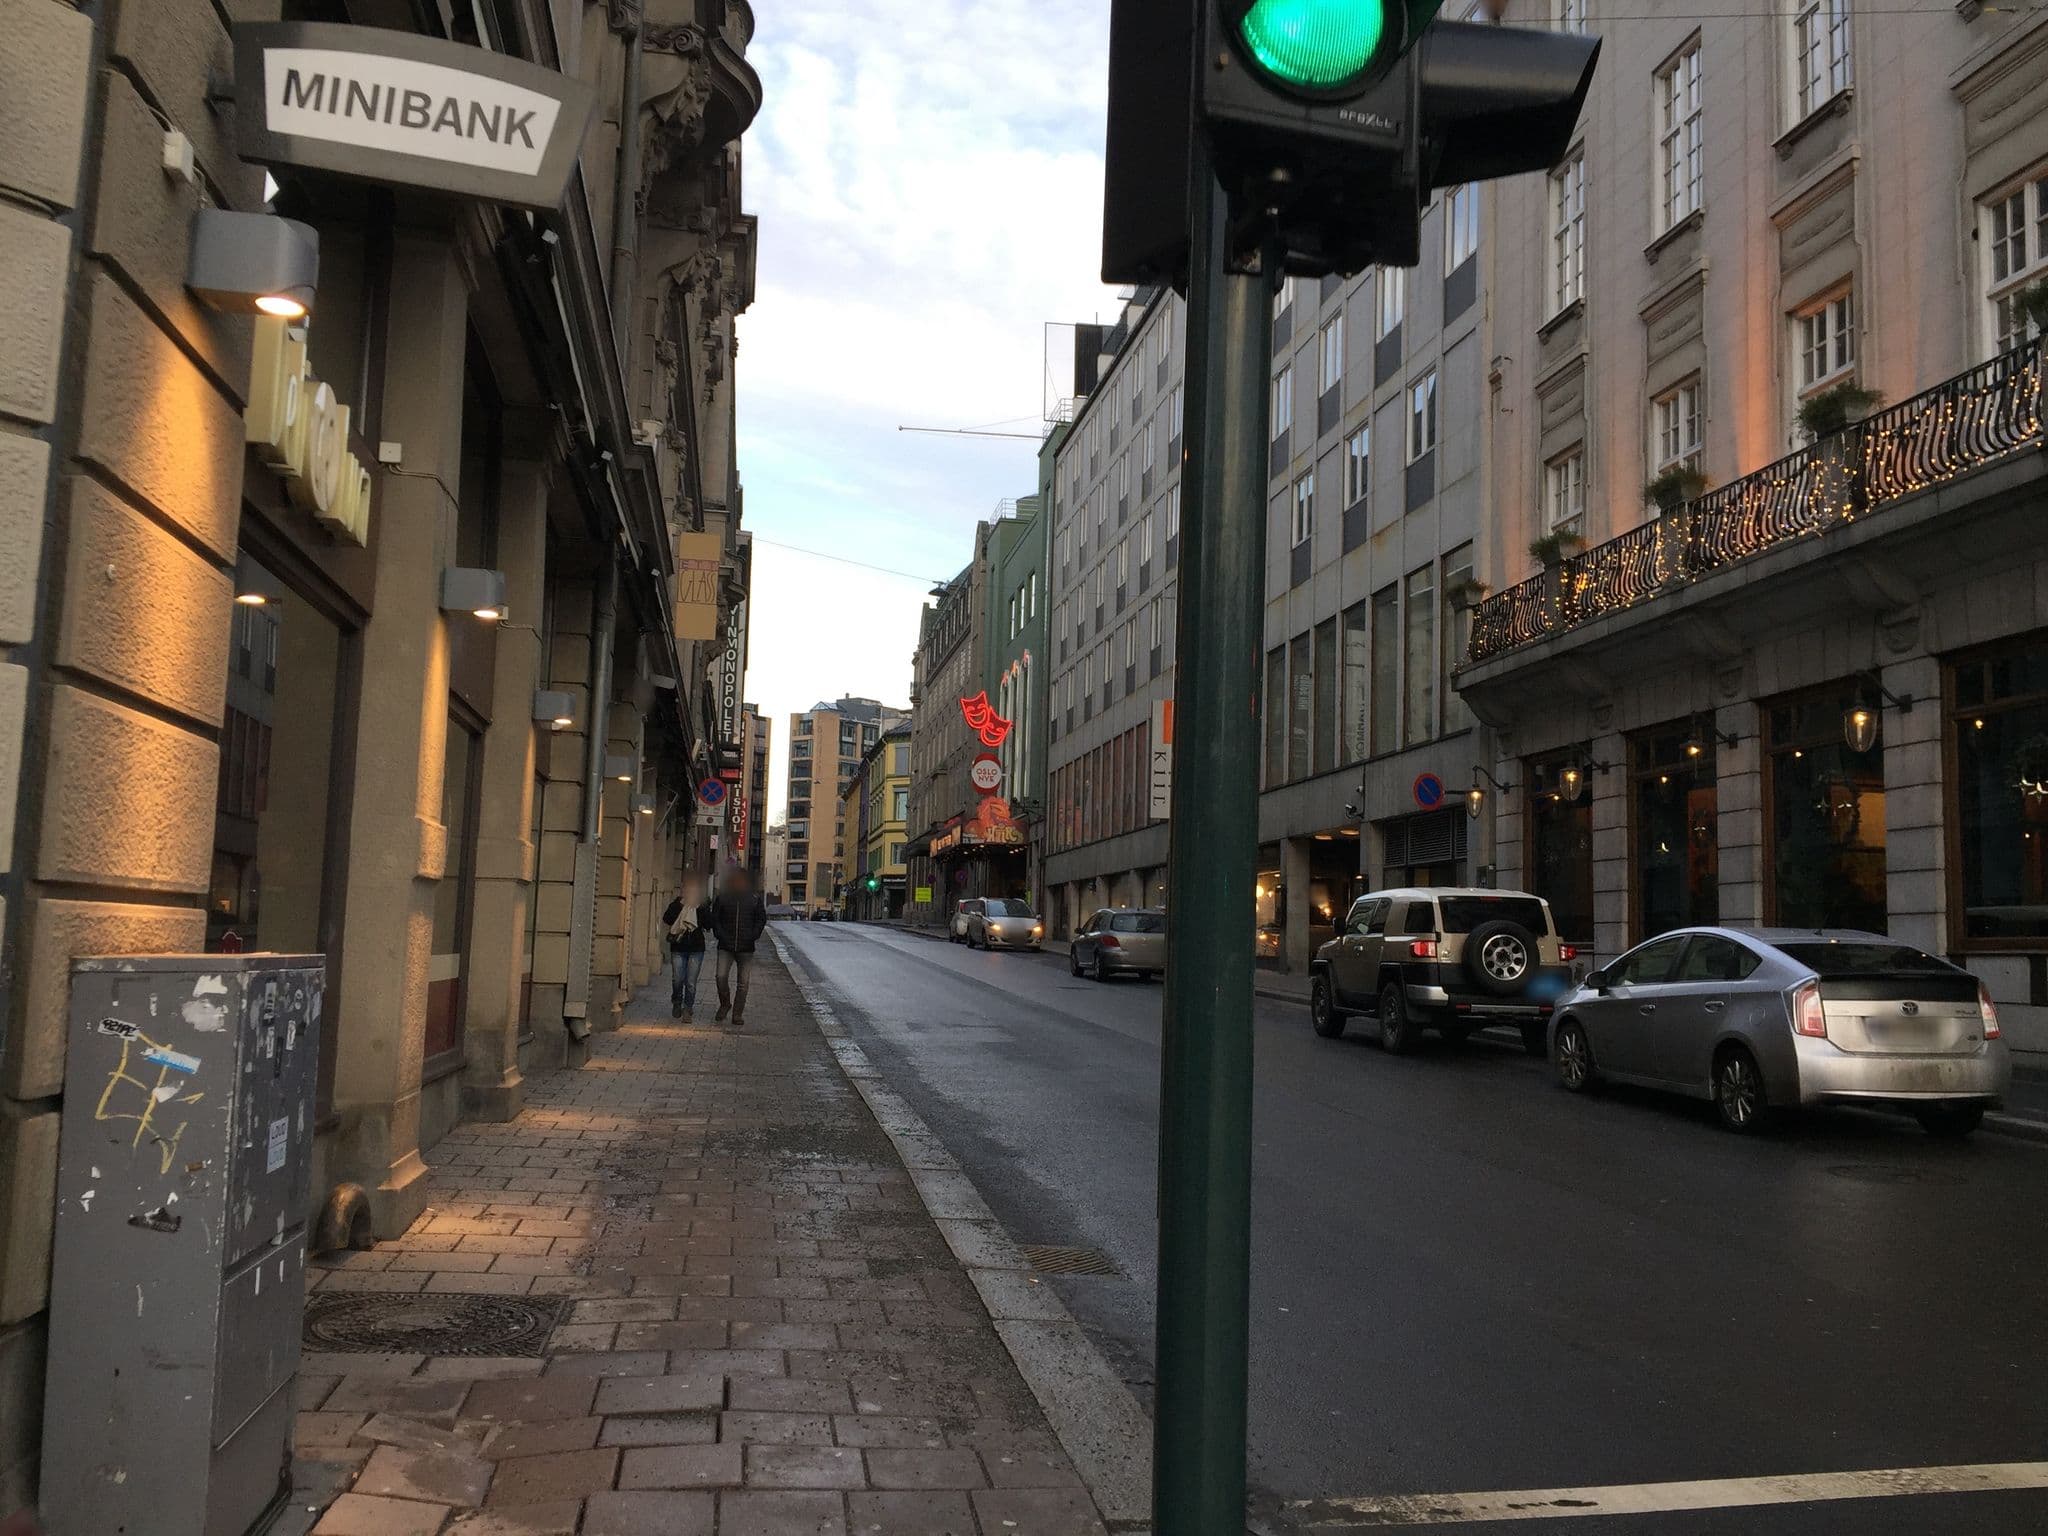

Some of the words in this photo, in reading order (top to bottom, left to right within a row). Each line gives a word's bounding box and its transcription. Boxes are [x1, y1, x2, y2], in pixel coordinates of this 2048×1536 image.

[281, 67, 538, 150] MINIBANK
[679, 570, 717, 603] GLASS
[722, 604, 739, 743] VINMONOPOLET
[976, 768, 998, 776] OSLO
